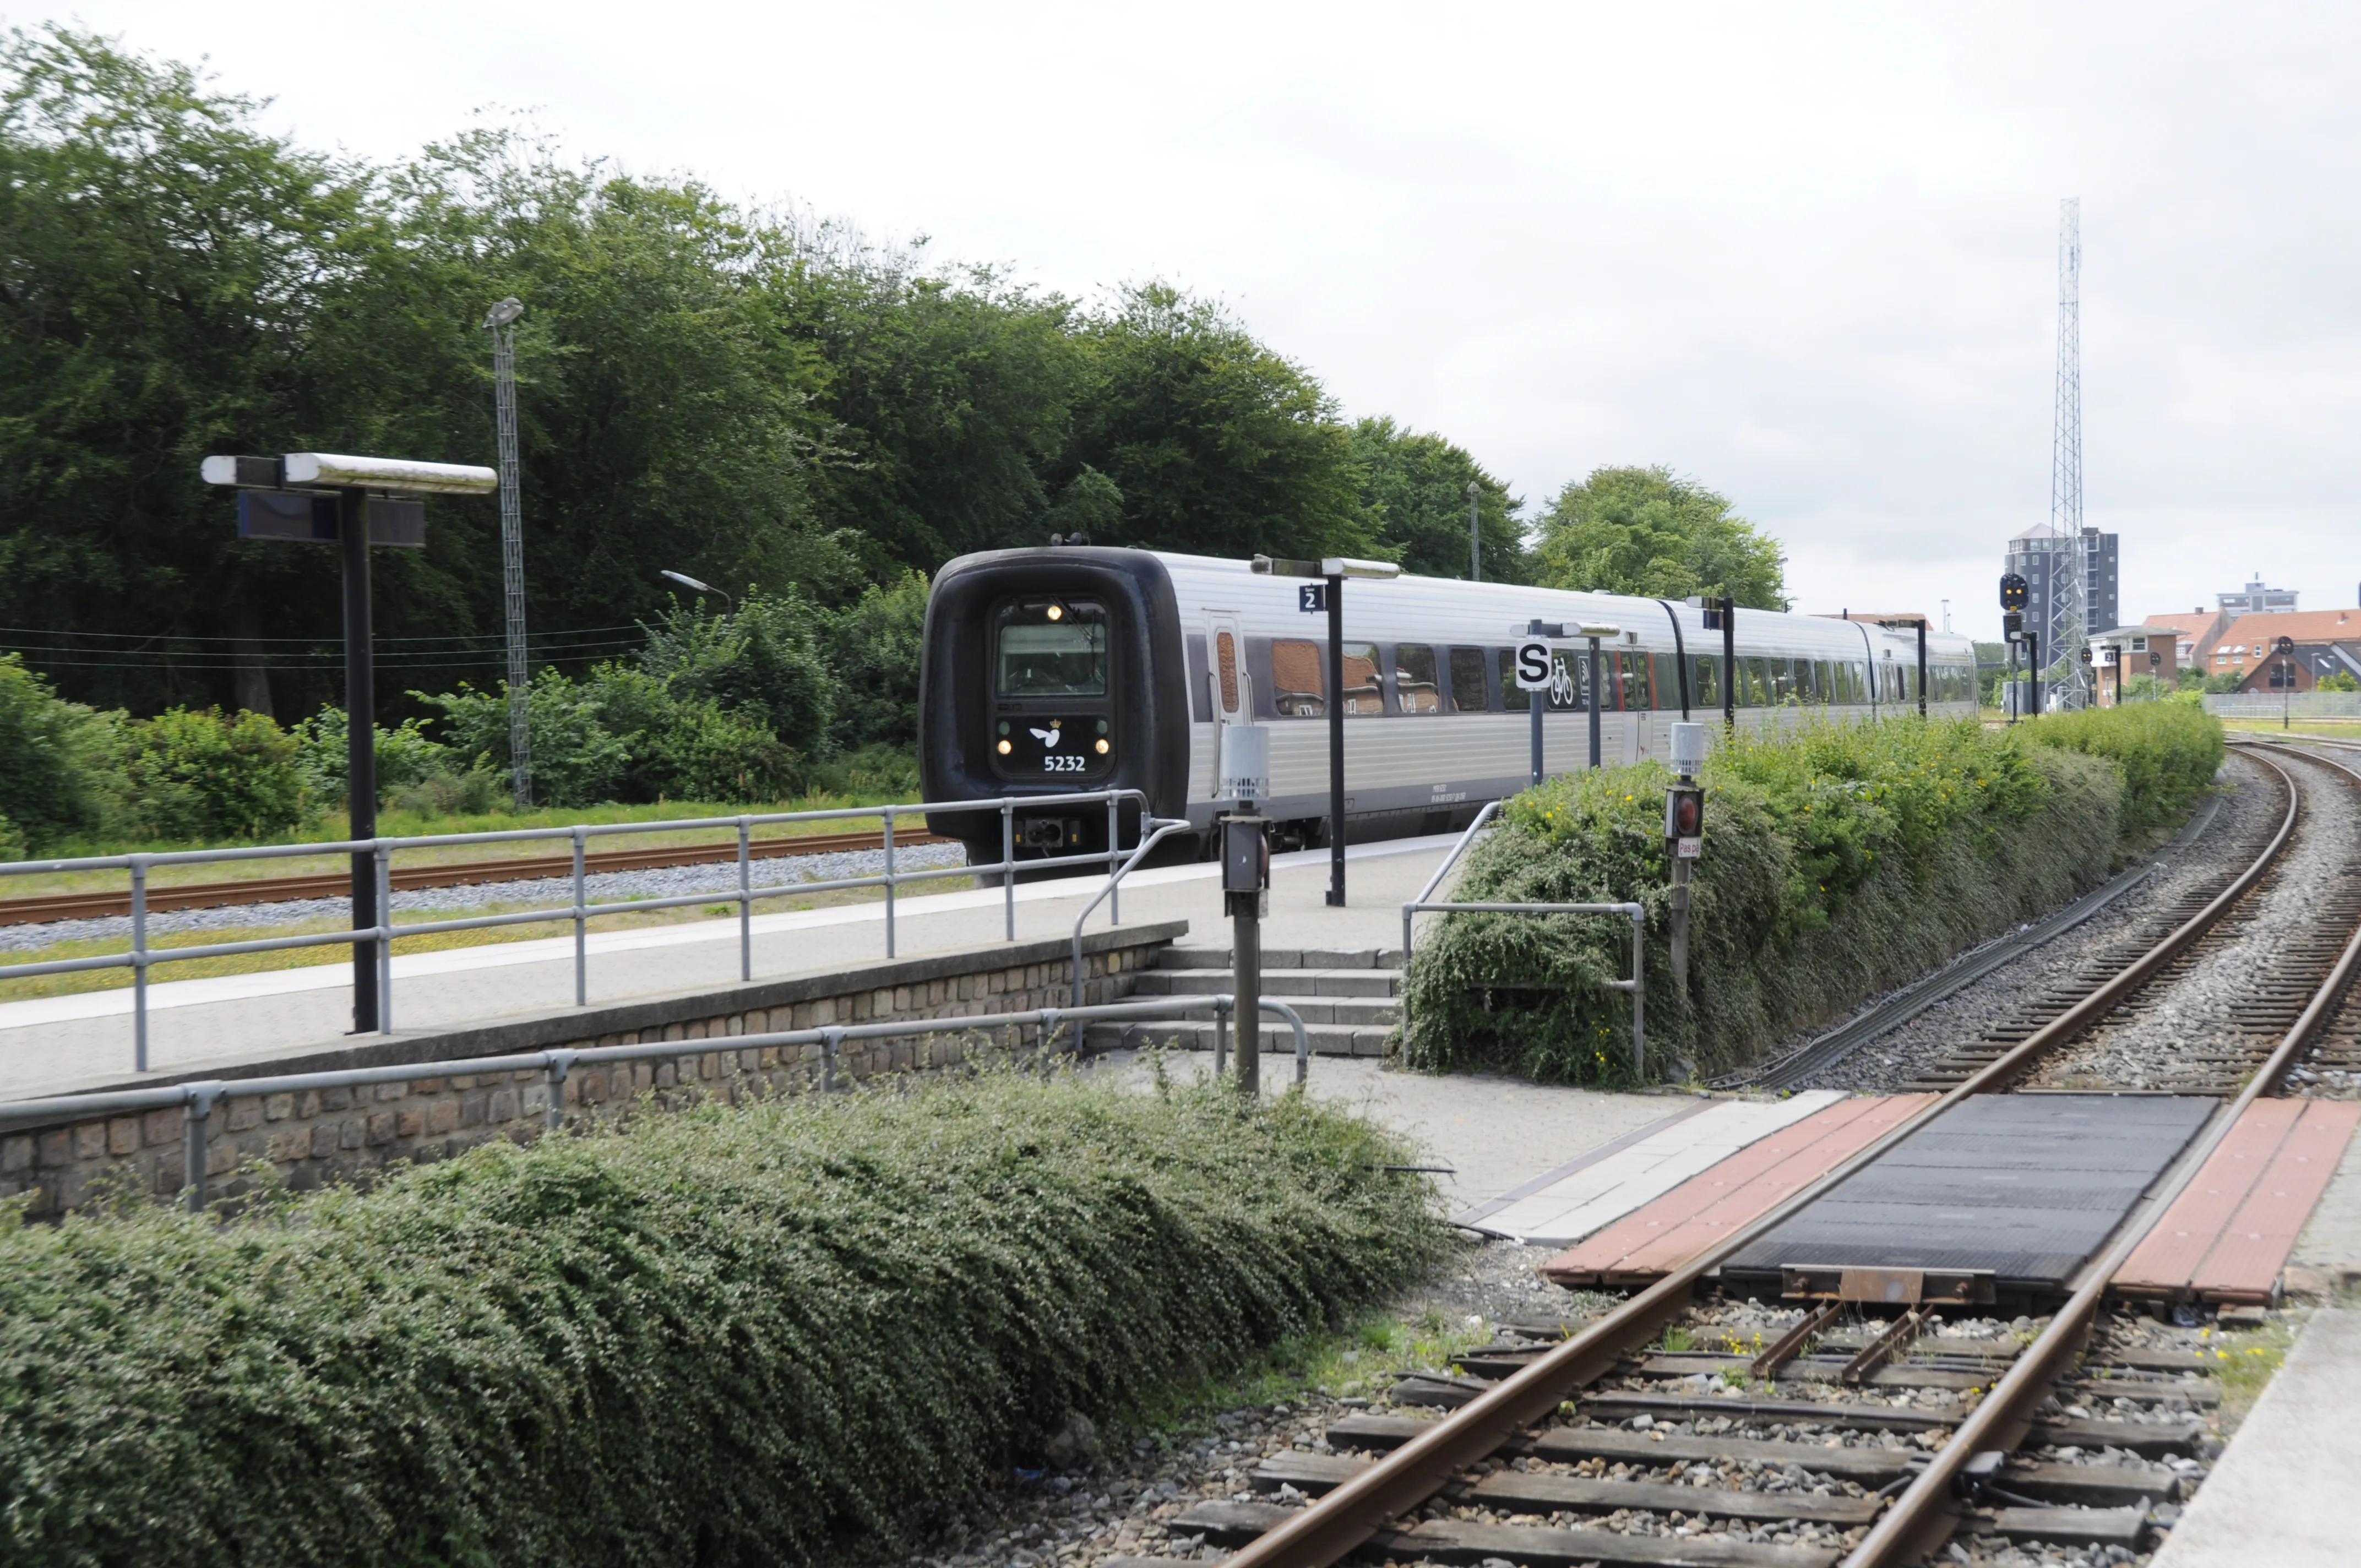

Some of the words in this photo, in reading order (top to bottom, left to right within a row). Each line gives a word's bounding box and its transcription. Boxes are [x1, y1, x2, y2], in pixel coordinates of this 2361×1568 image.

[1305, 592, 1315, 608] 2
[1519, 644, 1548, 682] S
[1045, 756, 1085, 771] 5232
[1680, 843, 1691, 853] Pas
